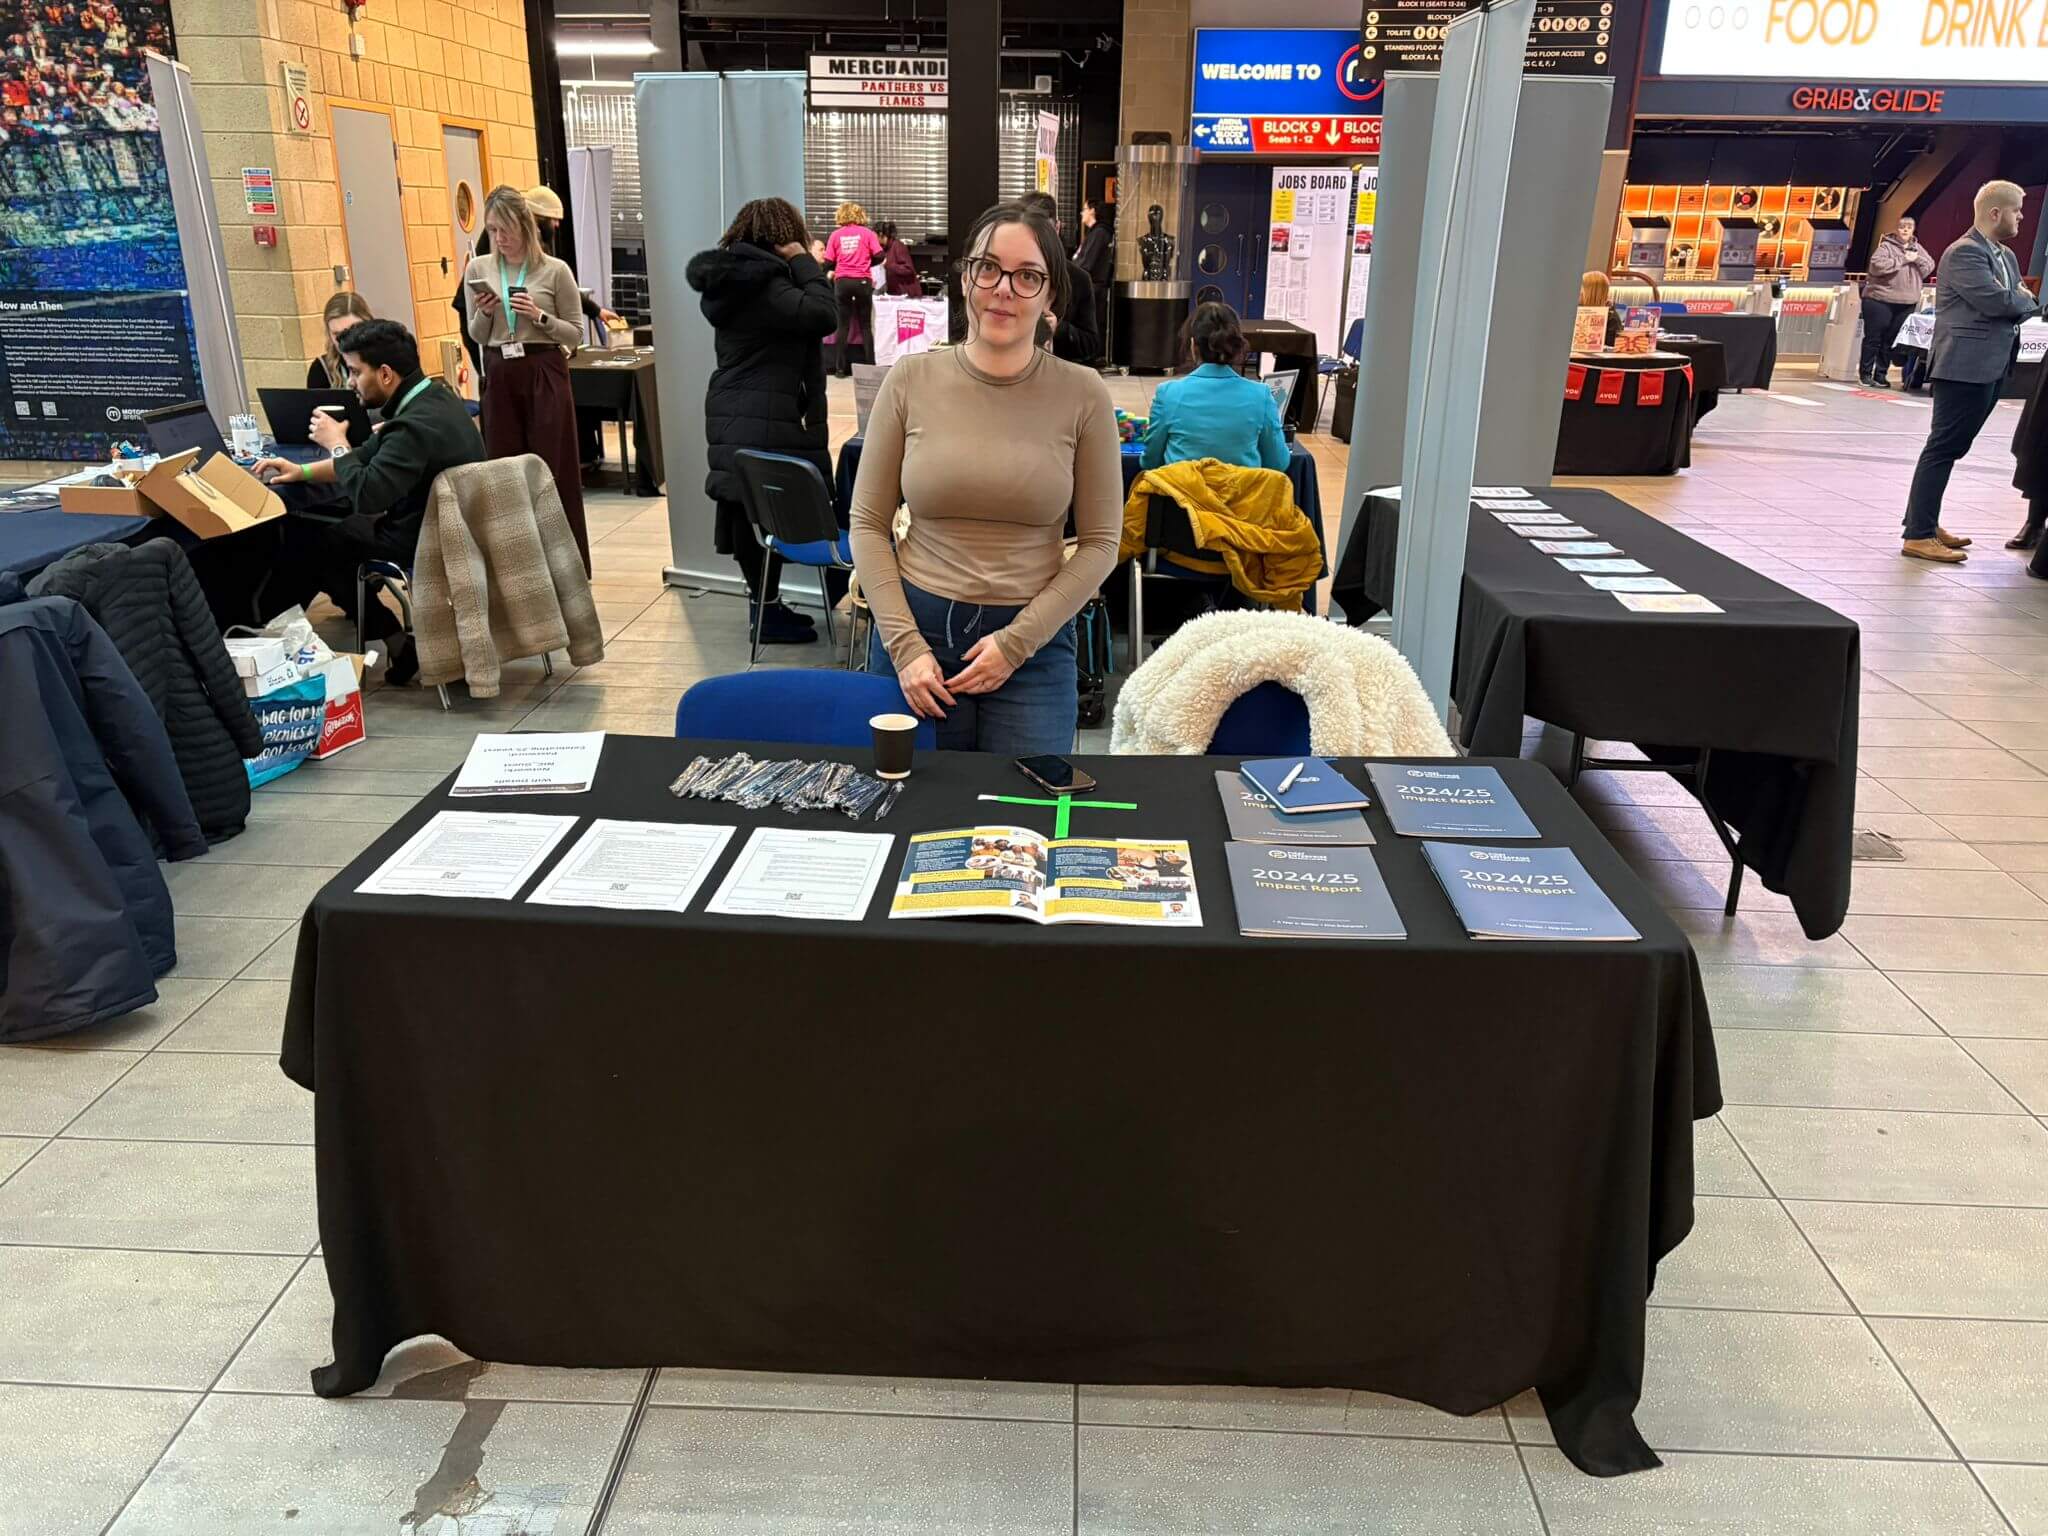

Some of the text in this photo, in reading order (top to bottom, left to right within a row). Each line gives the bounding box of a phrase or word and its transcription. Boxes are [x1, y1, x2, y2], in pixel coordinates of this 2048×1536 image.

[1764, 0, 1880, 45] FOOD
[1919, 0, 2034, 48] DRINK
[829, 58, 946, 76] MERCHANDI
[1201, 63, 1322, 80] WELCOME TO
[861, 81, 945, 93] PANTHERS VS
[879, 96, 925, 107] FLAMES
[1792, 87, 1945, 113] GRAB&GLIDE
[1263, 121, 1321, 133] BLOCK 9
[1343, 121, 1382, 134] BLOC
[1268, 136, 1291, 144] Seats
[1351, 136, 1374, 144] Seats
[1278, 175, 1347, 189] JOBS BOARD
[1364, 176, 1378, 190] JO
[20, 301, 38, 310] and
[39, 301, 64, 310] Then
[1782, 303, 1805, 312] NTRY
[2021, 342, 2047, 354] pass
[1395, 784, 1491, 798] 2024/25
[1241, 801, 1276, 809] Impa
[1400, 794, 1496, 806] Impact Report
[1252, 868, 1359, 884] 2024/25
[1458, 869, 1569, 886] 2024/25
[1255, 880, 1363, 894] Impact Report
[1466, 881, 1577, 897] Impact Report
